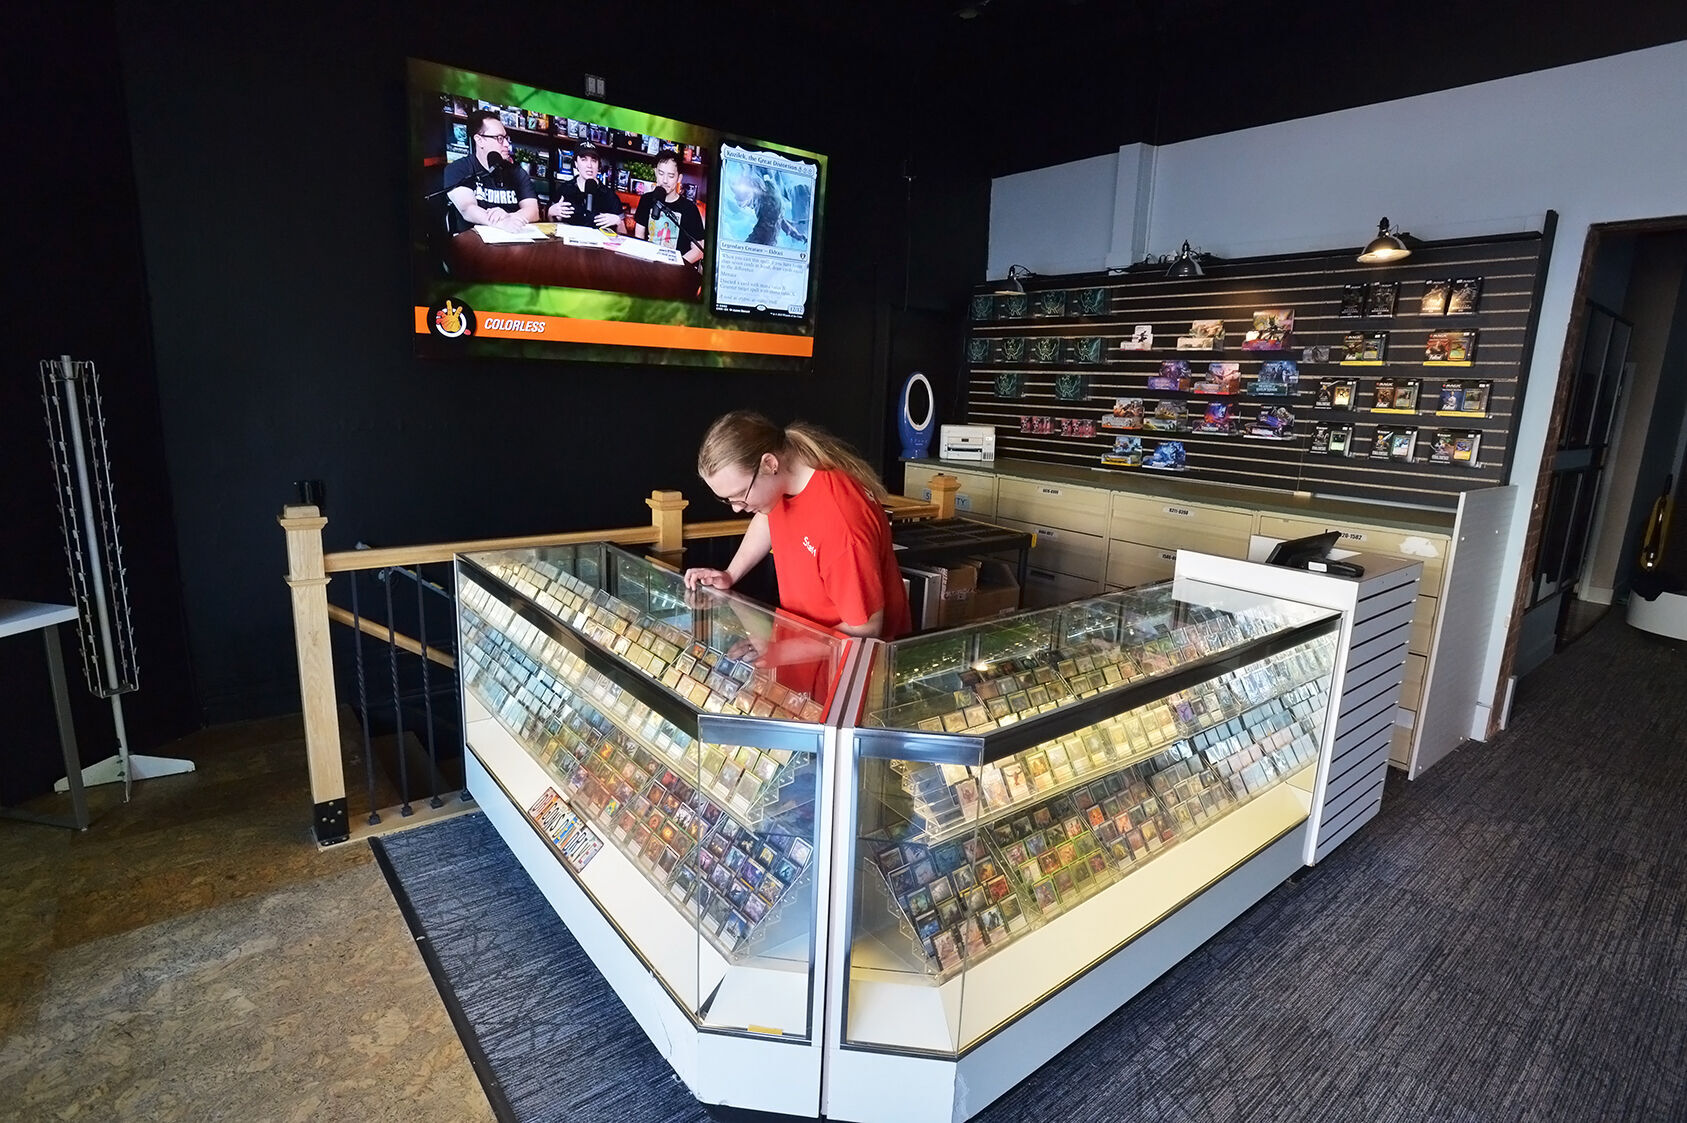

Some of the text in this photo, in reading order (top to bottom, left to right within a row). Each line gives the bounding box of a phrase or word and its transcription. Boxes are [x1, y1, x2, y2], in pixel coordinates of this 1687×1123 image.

[757, 156, 772, 165] Great
[772, 159, 797, 171] Distortion
[484, 318, 546, 333] COLORLESS
[531, 793, 567, 832] DRAGONS
